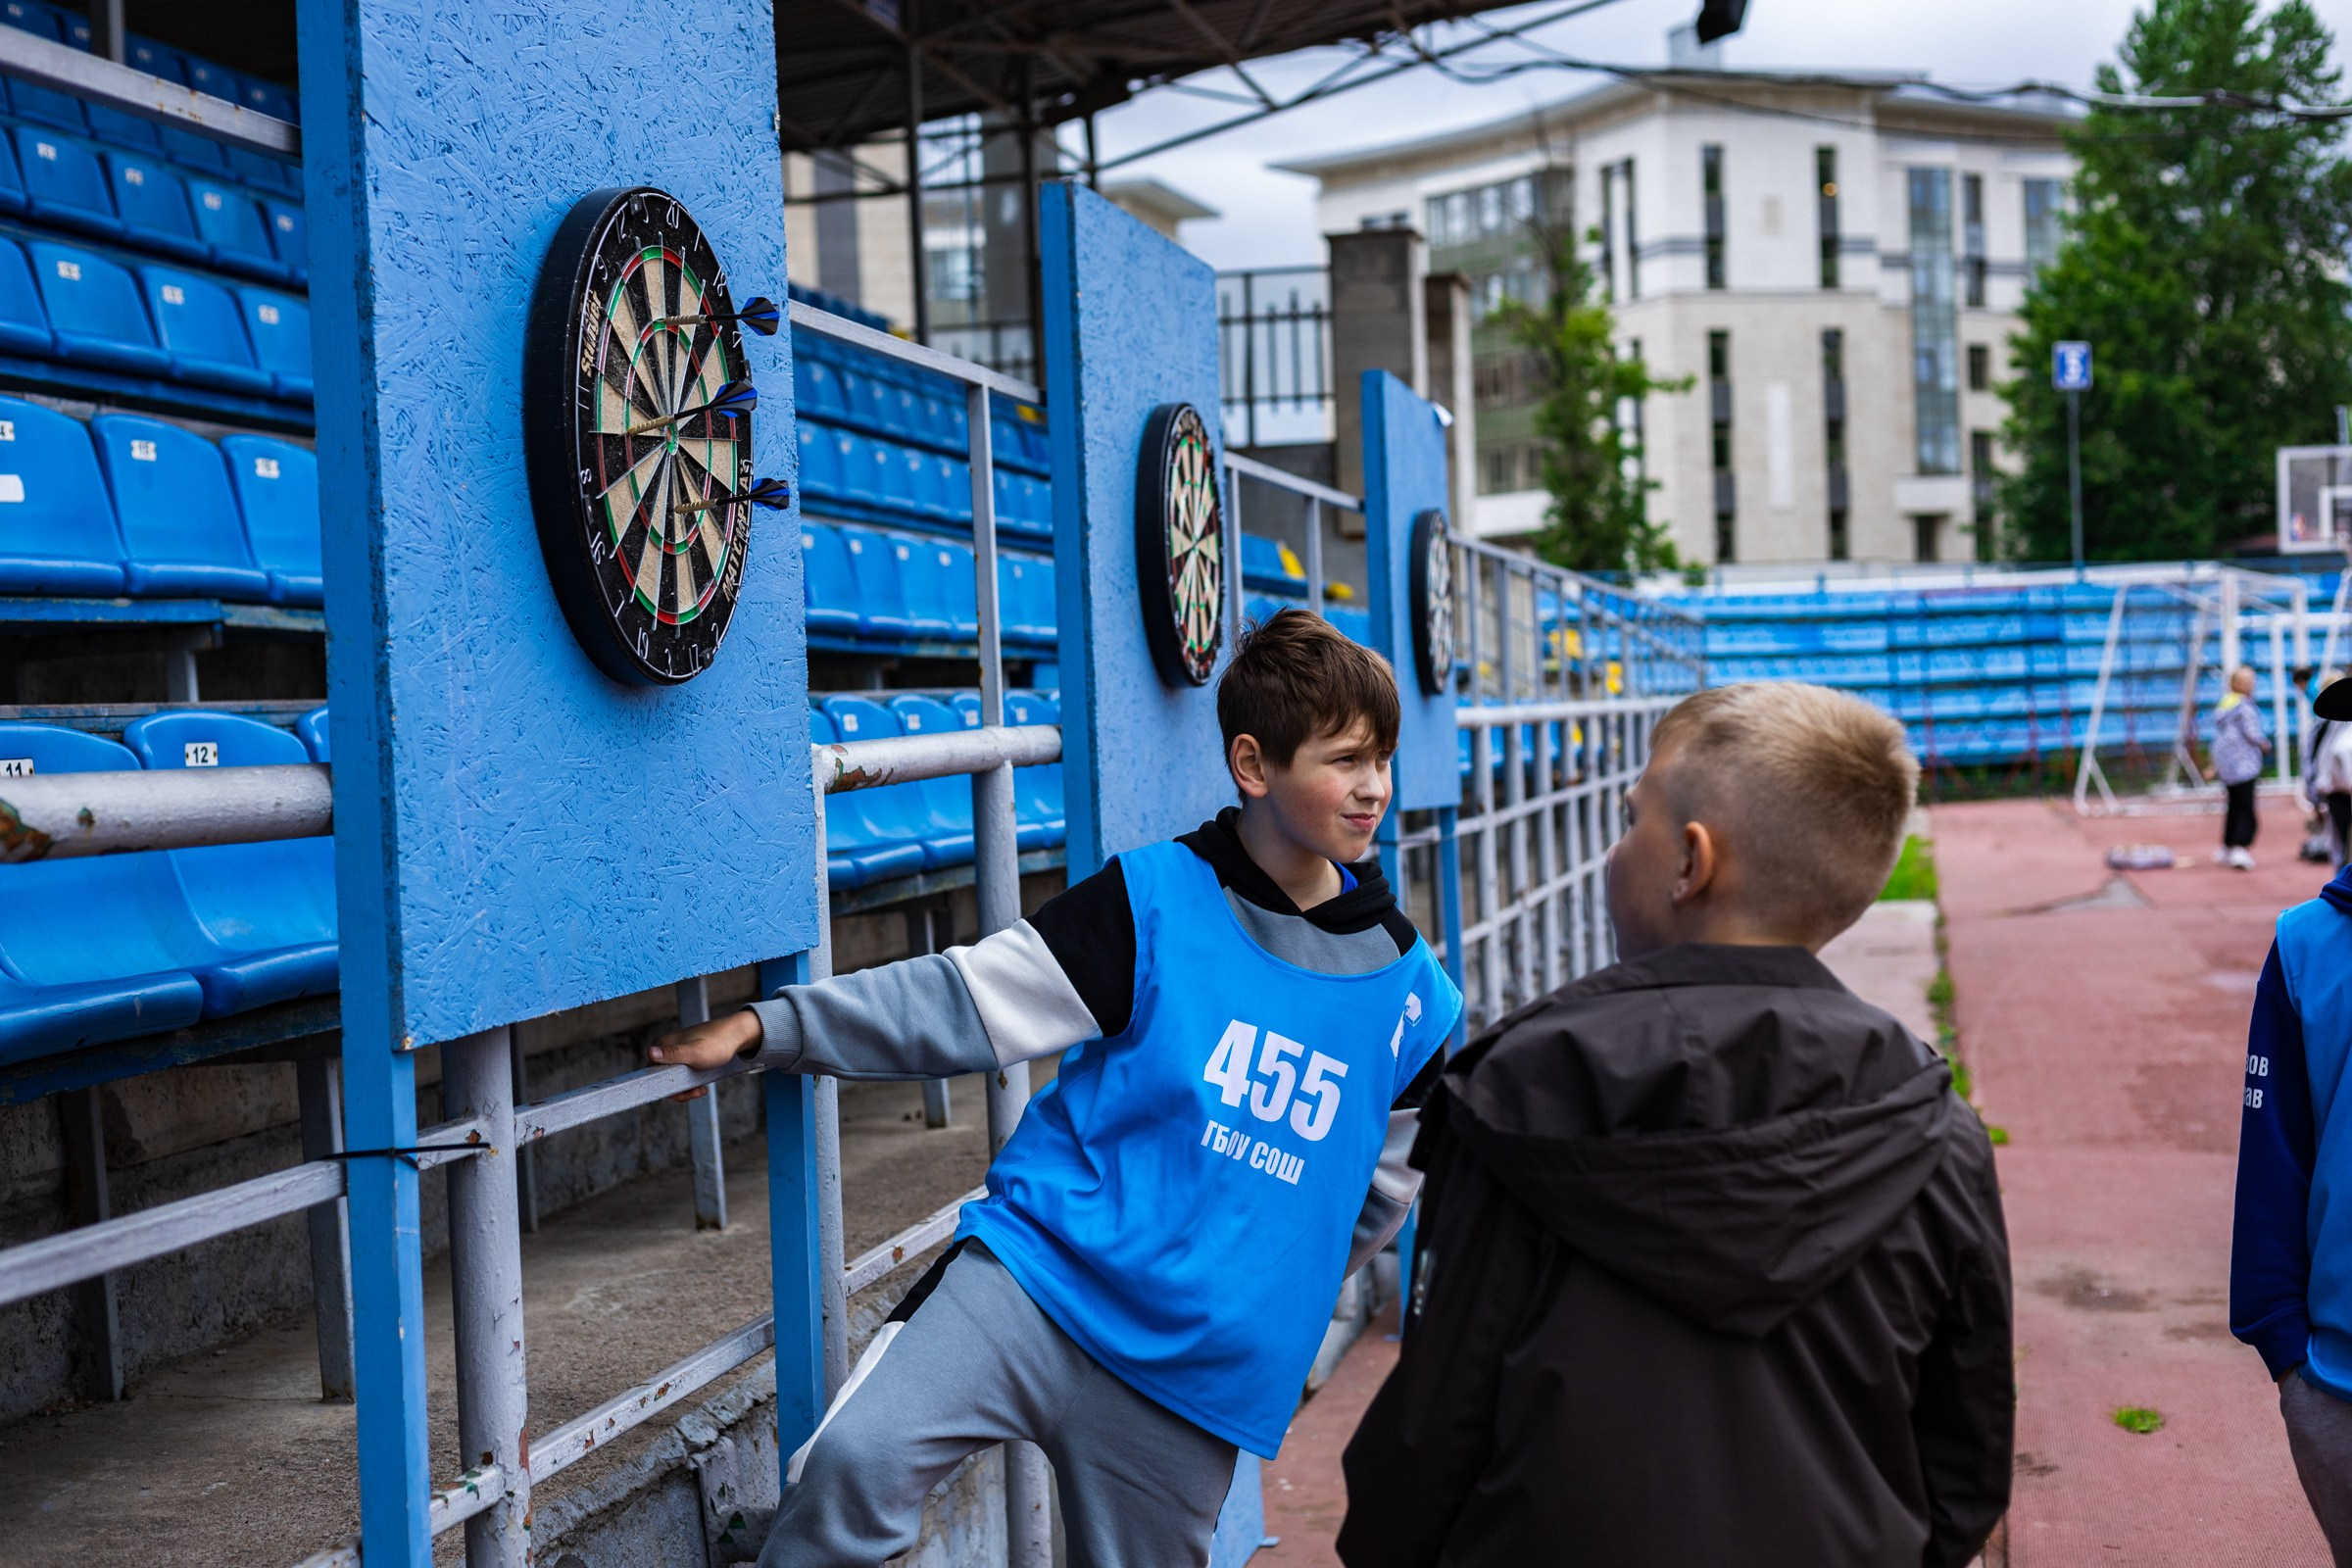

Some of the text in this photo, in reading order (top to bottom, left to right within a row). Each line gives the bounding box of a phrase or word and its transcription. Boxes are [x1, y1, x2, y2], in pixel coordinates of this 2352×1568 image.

[712, 265, 727, 297] 18
[579, 467, 593, 485] 8
[590, 531, 606, 565] 16
[637, 626, 650, 662] 19
[6, 761, 23, 777] 11
[192, 746, 209, 763] 12
[1202, 1018, 1349, 1142] 455
[1200, 1119, 1305, 1186] ГБОУ СОШ
